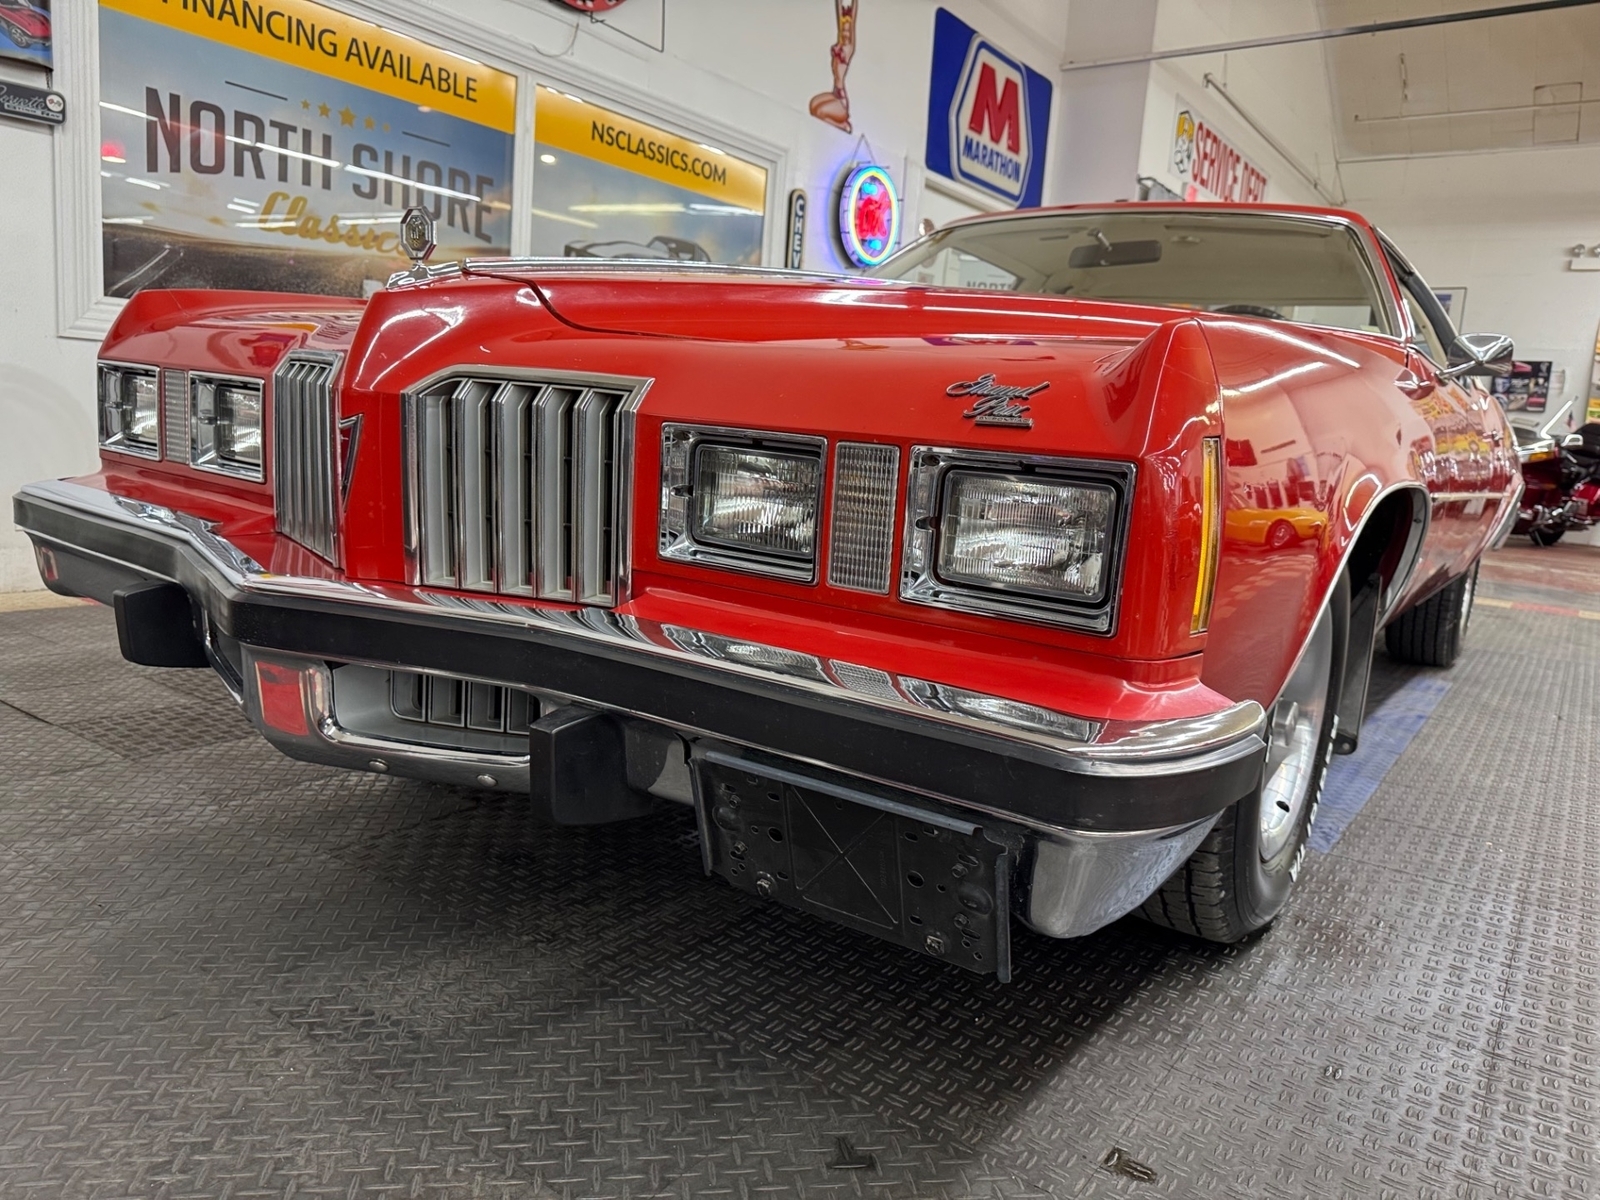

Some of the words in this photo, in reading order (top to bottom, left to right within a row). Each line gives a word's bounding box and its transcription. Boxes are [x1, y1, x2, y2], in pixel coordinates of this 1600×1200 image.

[344, 36, 479, 104] AVAILABLE
[968, 61, 1021, 156] M
[145, 86, 332, 191] NORTH
[353, 142, 494, 245] SHORE
[590, 120, 727, 187] NSCLASSICS.COM
[962, 135, 1021, 183] MARATHON
[1192, 121, 1241, 203] SERVICE
